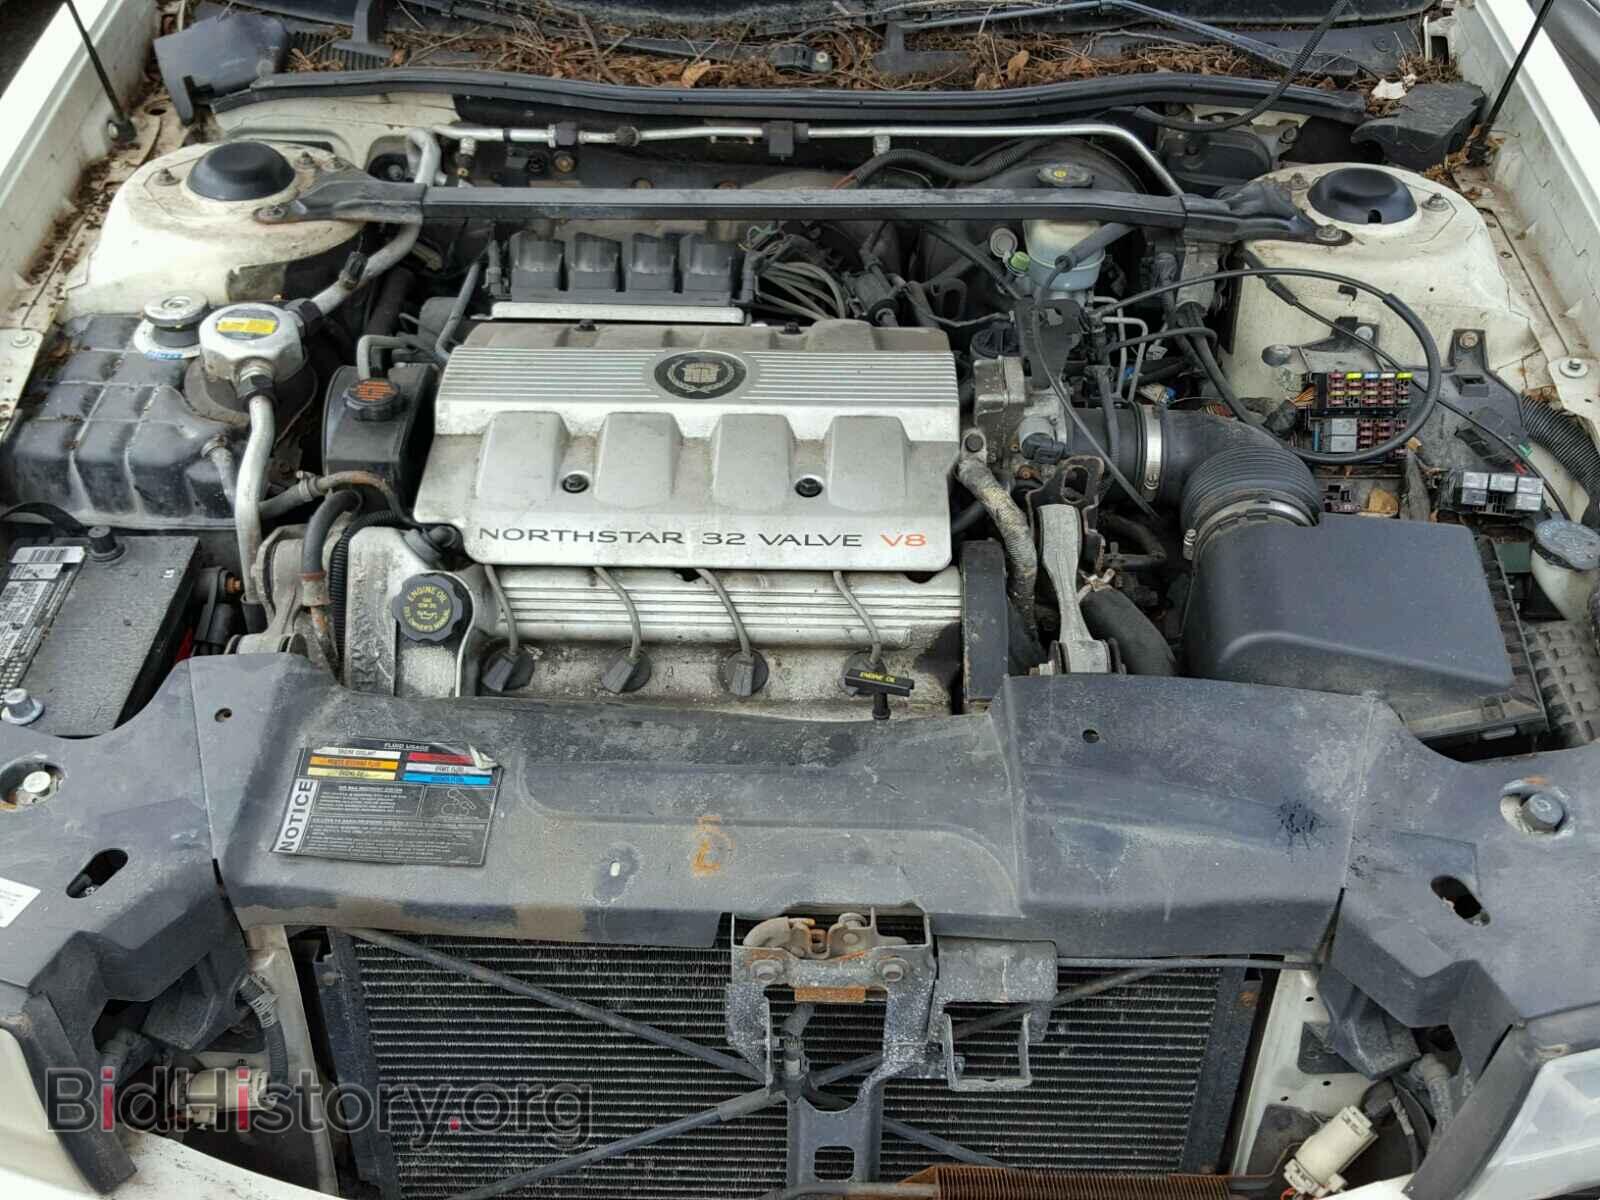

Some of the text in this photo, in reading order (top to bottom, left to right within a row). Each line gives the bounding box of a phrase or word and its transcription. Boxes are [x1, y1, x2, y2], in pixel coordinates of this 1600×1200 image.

[479, 528, 927, 547] NORTHSTAR 32 VALVE V8
[408, 585, 434, 601] ENGINE
[859, 671, 895, 683] ENGINE OIL
[384, 742, 429, 752] FLUID USAGE
[278, 781, 313, 851] NOTICE
